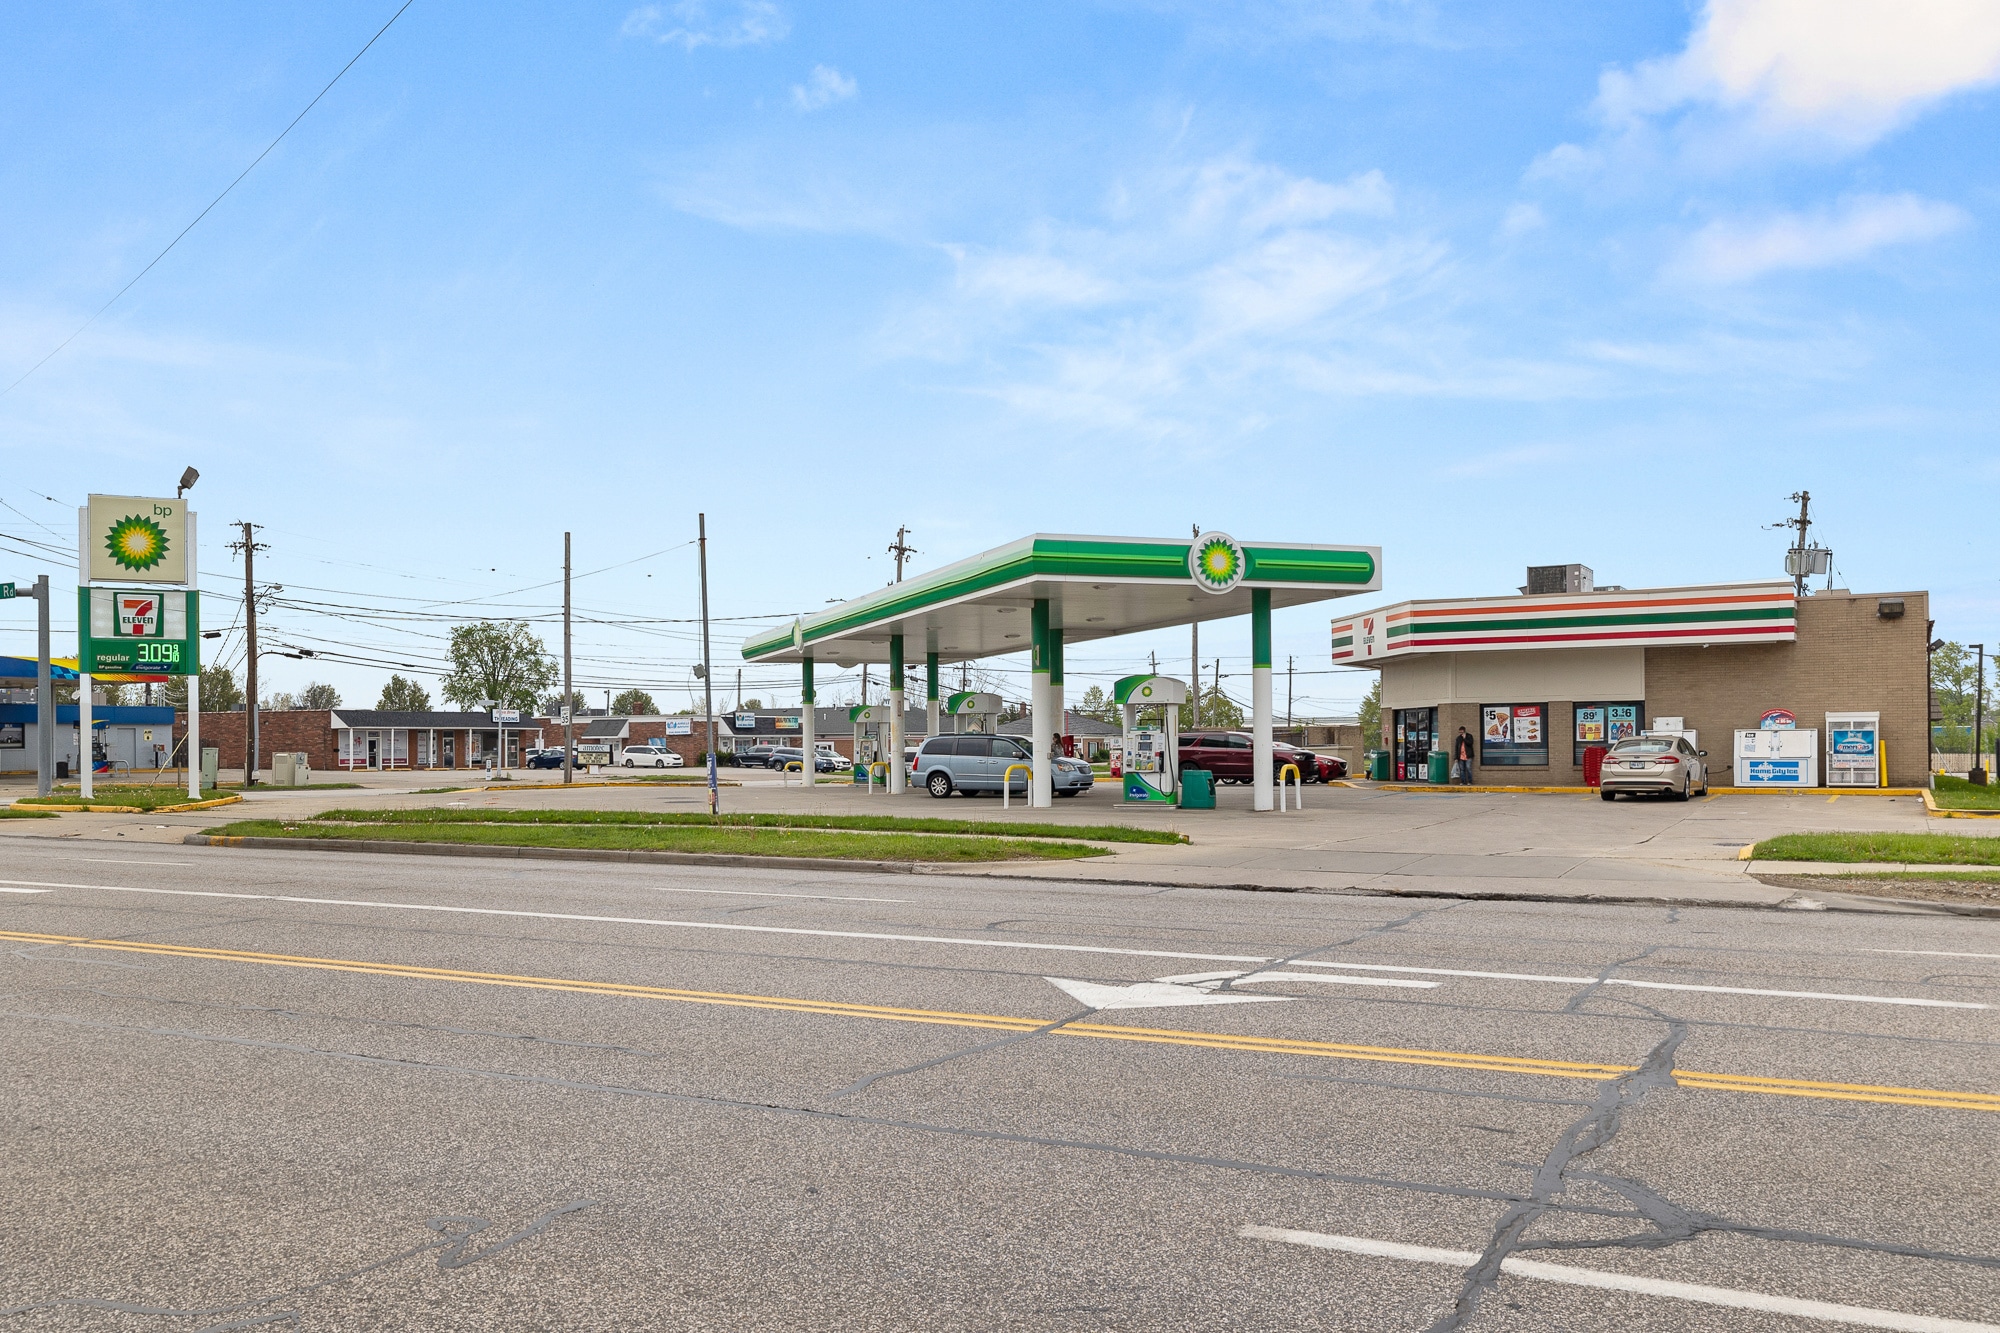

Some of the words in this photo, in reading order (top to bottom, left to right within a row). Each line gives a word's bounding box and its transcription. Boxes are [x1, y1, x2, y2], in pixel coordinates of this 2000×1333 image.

[153, 503, 172, 518] bp
[3, 585, 14, 597] Rd
[123, 599, 153, 635] 7
[96, 653, 130, 662] regular
[561, 715, 569, 723] 35
